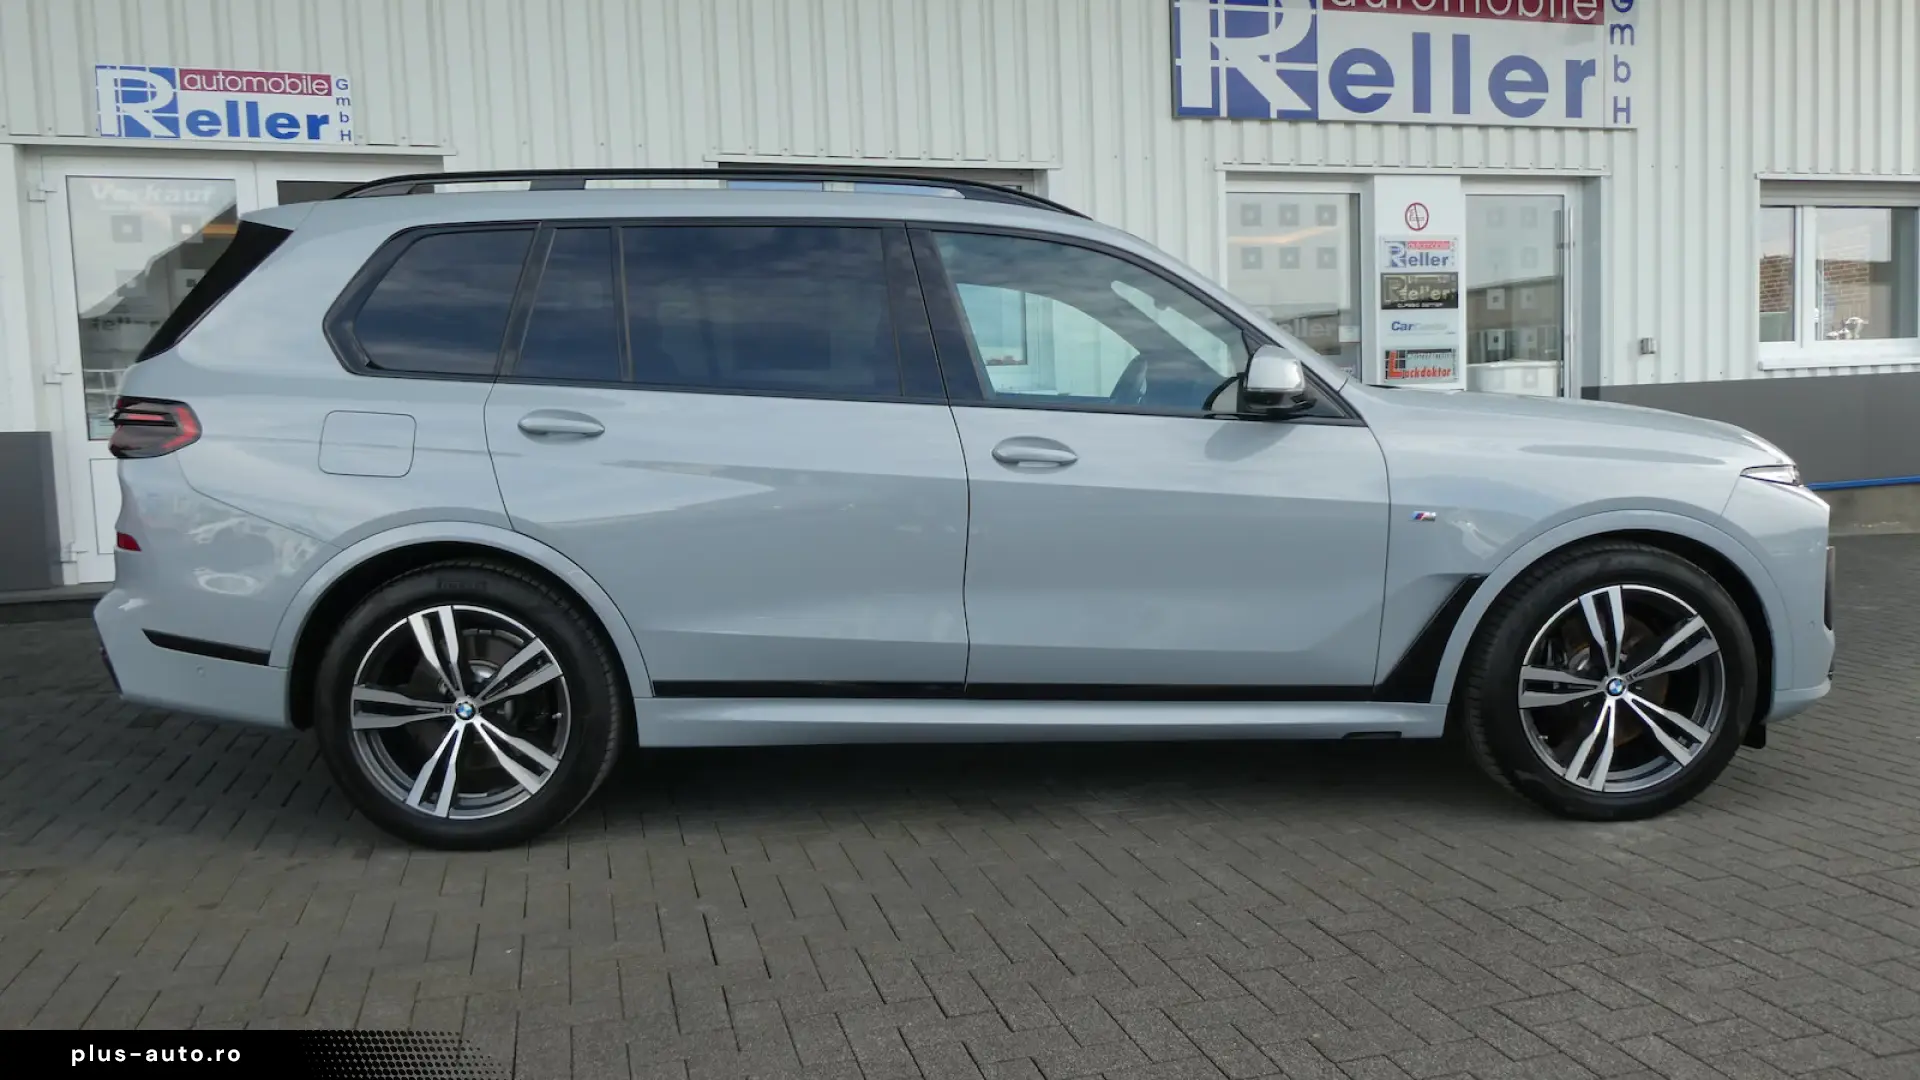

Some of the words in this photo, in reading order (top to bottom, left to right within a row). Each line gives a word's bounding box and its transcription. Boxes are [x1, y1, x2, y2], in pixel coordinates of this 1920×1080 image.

[183, 72, 329, 96] automobile
[1175, 0, 1596, 118] Reller
[95, 66, 329, 139] Reller
[335, 78, 352, 142] GmbH
[1384, 240, 1448, 269] Reller
